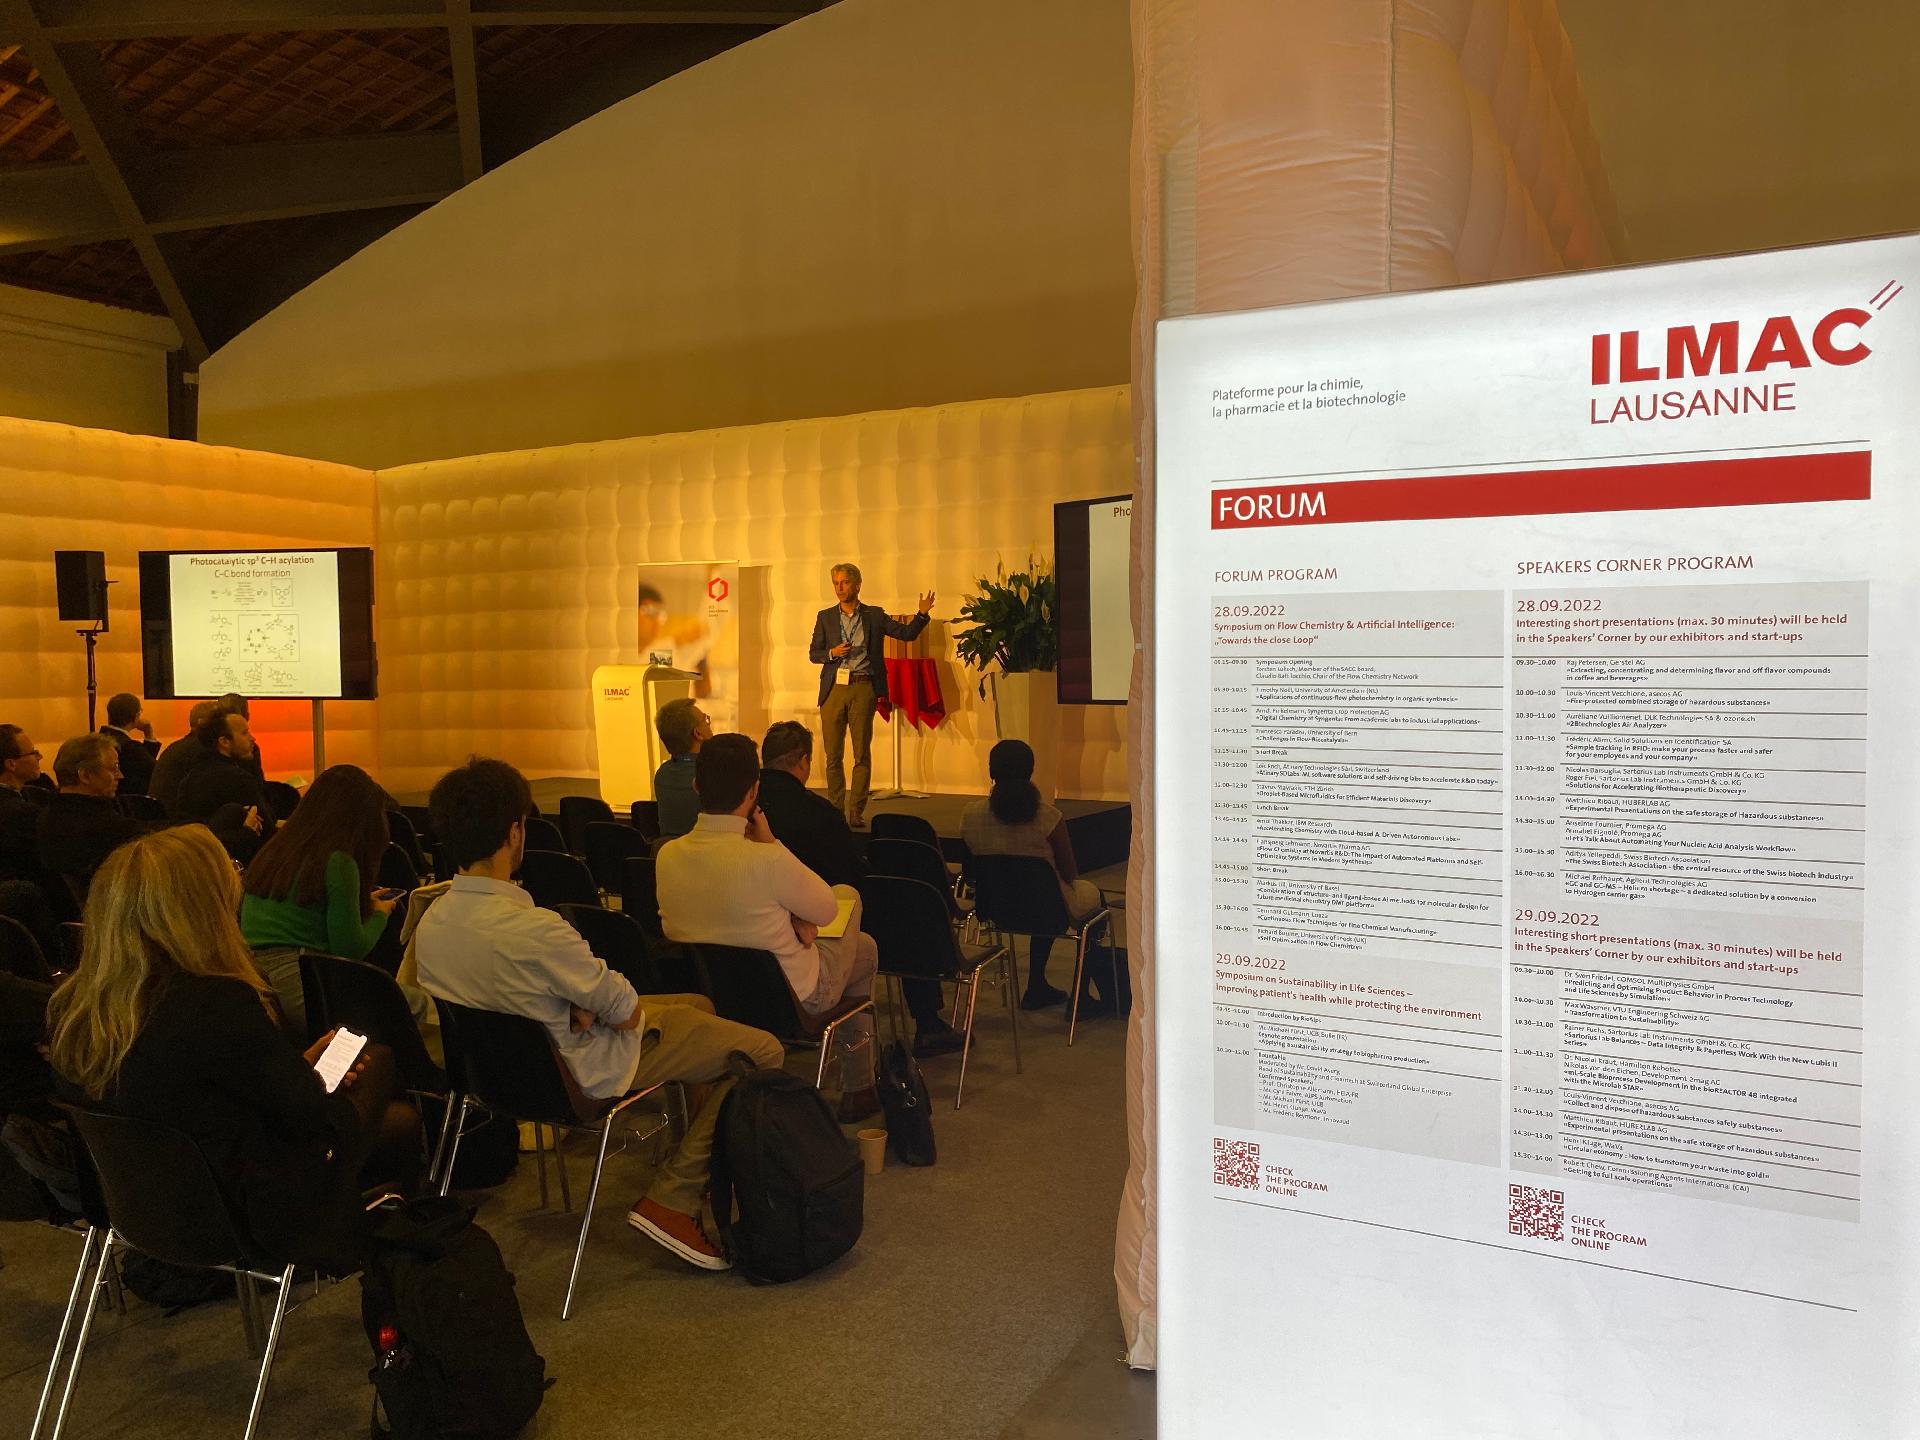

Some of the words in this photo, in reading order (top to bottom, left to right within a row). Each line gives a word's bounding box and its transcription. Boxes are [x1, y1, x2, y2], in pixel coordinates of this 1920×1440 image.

[1591, 308, 1873, 386] ILMAC
[1212, 386, 1274, 401] Plateforme
[1278, 384, 1304, 398] pour
[1308, 381, 1317, 392] la
[1320, 377, 1363, 391] chimie,
[1212, 403, 1222, 418] la
[1225, 401, 1285, 418] pharmacie
[1288, 400, 1300, 411] et
[1302, 398, 1312, 410] la
[1316, 390, 1406, 409] biotechnologie
[1591, 382, 1796, 424] LAUSANNE
[1220, 491, 1326, 521] FORUM
[1518, 560, 1592, 575] SPEAKERS
[1596, 558, 1662, 572] CORNER
[1668, 555, 1753, 571] PROGRAM
[1215, 570, 1263, 582] FORUM
[1268, 568, 1338, 581] PROGRAM
[1215, 605, 1285, 617] 28.09.2022
[1517, 599, 1602, 612] 28.09.2022
[1214, 622, 1262, 633] Symposium
[1278, 622, 1298, 630] Flow
[1300, 621, 1344, 632] Chemistry
[1346, 620, 1354, 629] &
[1356, 620, 1395, 629] Artificial
[1398, 619, 1454, 630] Intelligence:
[1517, 618, 1570, 630] Interesting
[1573, 618, 1600, 627] short
[1602, 617, 1674, 630] presentations
[1678, 616, 1708, 628] (max.
[1711, 616, 1724, 626] 30
[1728, 615, 1777, 627] minutes)
[1780, 614, 1801, 624] will
[1804, 614, 1818, 624] be
[1822, 614, 1847, 624] held
[1254, 636, 1268, 644] the
[1269, 636, 1290, 644] close
[1516, 634, 1526, 643] in
[1528, 634, 1544, 643] the
[1598, 634, 1632, 642] Corner
[1634, 633, 1647, 645] by
[1670, 632, 1724, 642] exhibitors
[1728, 632, 1748, 641] and
[1752, 632, 1803, 644] start-ups
[1516, 909, 1599, 927] 29.09.2022
[1515, 927, 1568, 942] Interesting
[1570, 931, 1597, 942] short
[1600, 936, 1671, 948] presentations
[1674, 938, 1704, 951] (max.
[1708, 942, 1720, 952] 30
[1724, 944, 1773, 958] minutes)
[1776, 948, 1796, 958] will
[1800, 950, 1814, 960] be
[1818, 951, 1842, 962] held
[1216, 953, 1286, 971] 29.09.2022
[1515, 941, 1524, 951] in
[1526, 942, 1542, 952] the
[1594, 949, 1629, 960] Corner
[1631, 951, 1644, 963] by
[1646, 955, 1664, 963] our
[1667, 955, 1720, 968] exhibitors
[1724, 960, 1744, 970] and
[1748, 962, 1798, 976] start-ups
[1216, 970, 1264, 982] Symposium
[1266, 976, 1276, 984] on
[1278, 976, 1338, 992] Sustainability
[1340, 982, 1348, 991] in
[1350, 984, 1366, 993] Life
[1368, 986, 1405, 998] Sciences
[1216, 983, 1258, 998] Improving
[1300, 994, 1326, 1002] health
[1328, 996, 1352, 1006] while
[1356, 1000, 1402, 1014] protecting
[1404, 1004, 1419, 1013] the
[1421, 1008, 1482, 1021] environment
[1266, 1165, 1294, 1176] CHECK
[1266, 1175, 1281, 1185] THE
[1284, 1178, 1328, 1192] PROGRAM
[1266, 1185, 1297, 1197] ONLINE
[1571, 1215, 1606, 1229] CHECK
[1571, 1226, 1590, 1237] THE
[1594, 1230, 1647, 1247] PROGRAM
[1571, 1237, 1610, 1251] ONLINE
